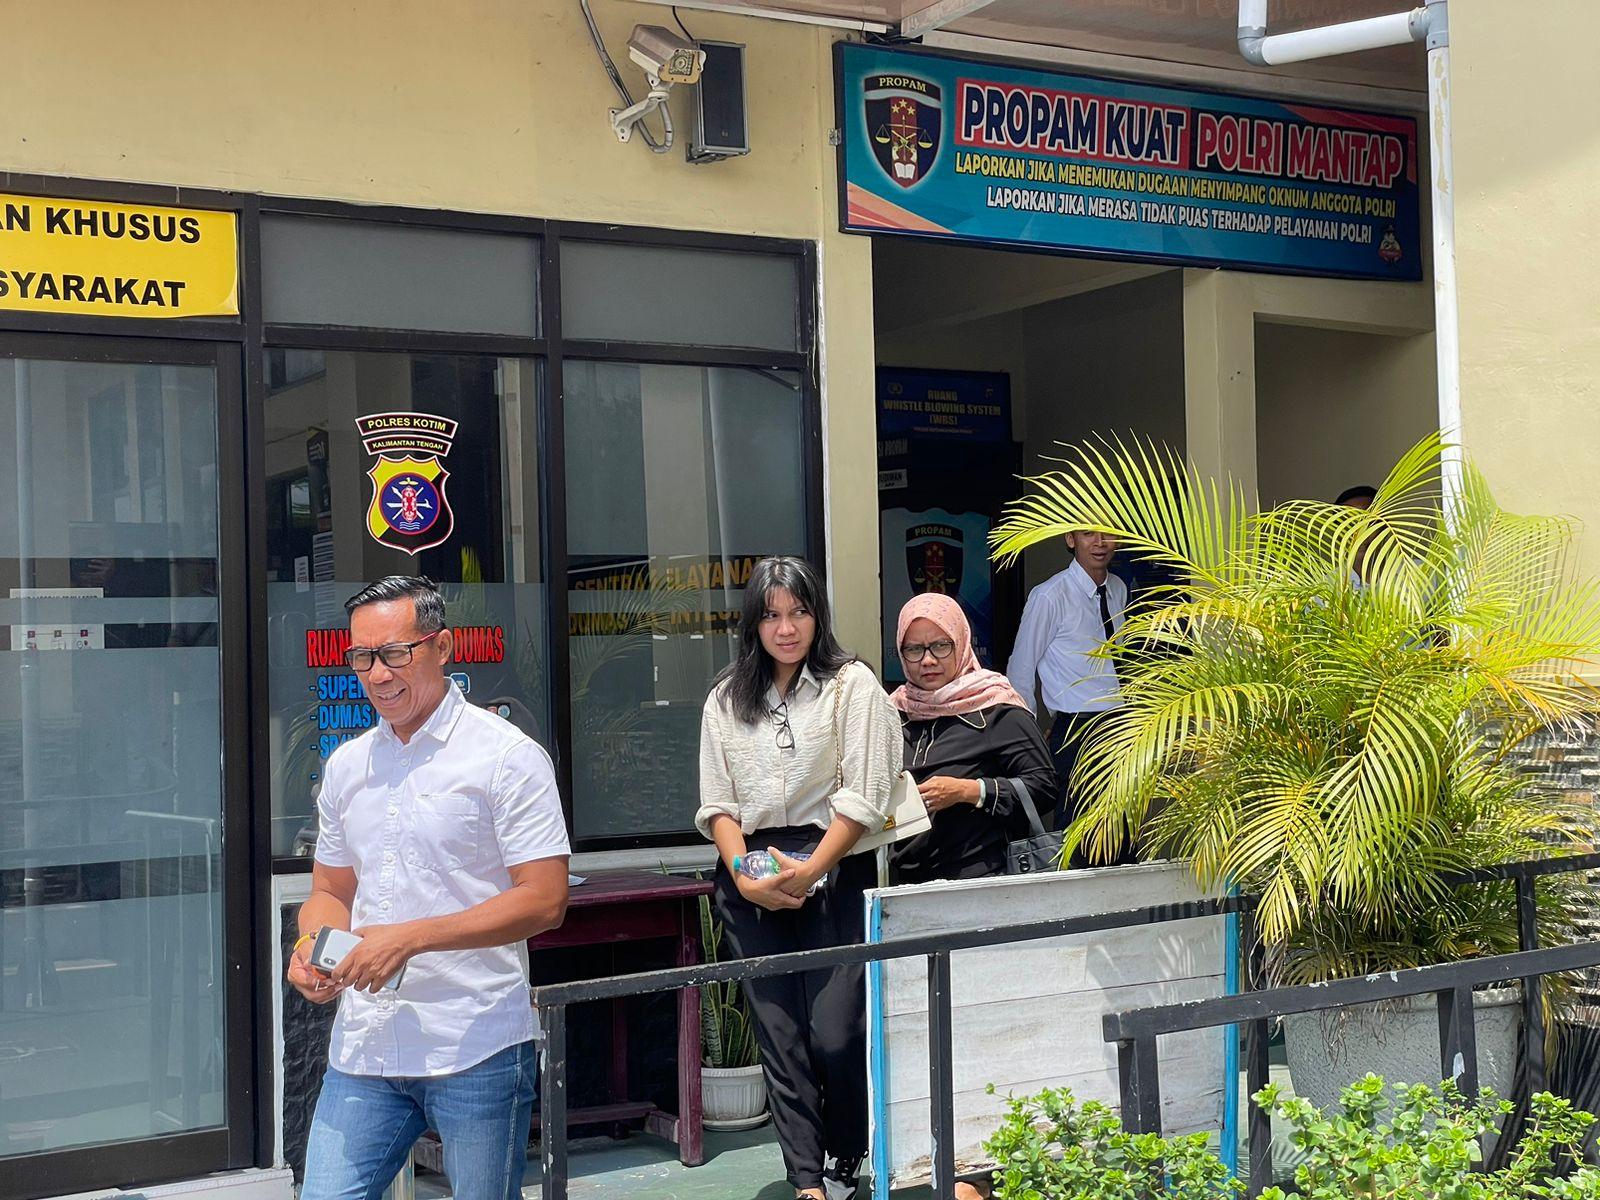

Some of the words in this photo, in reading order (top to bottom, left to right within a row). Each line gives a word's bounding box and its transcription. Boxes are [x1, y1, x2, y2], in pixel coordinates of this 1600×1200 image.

[879, 77, 927, 94] PROPAM
[963, 84, 1100, 154] PROPAM
[1104, 102, 1187, 165] KUAT
[1196, 113, 1283, 177] POLRI
[1287, 125, 1403, 189] MANTAP
[956, 151, 1024, 179] LAPORKAN
[1027, 161, 1055, 183] JIKA
[1058, 163, 1135, 192] MENEMUKAN
[1138, 172, 1188, 197] DUGAAN
[1190, 178, 1266, 206] MENYIMPANG
[1270, 187, 1308, 208] OKNUM
[1311, 191, 1362, 215] ANGGOTA
[1365, 197, 1396, 219] POLRI
[46, 206, 201, 244] KHUSUS
[987, 186, 1056, 213] LAPORKAN
[1058, 192, 1085, 216] JIKA
[1088, 197, 1138, 221] MERASA
[1141, 203, 1176, 225] TIDAK
[1178, 207, 1209, 228] PUAS
[1211, 210, 1271, 234] TERHADAP
[1274, 216, 1338, 241] PELAYANAN
[1340, 222, 1372, 244] POLRI
[367, 417, 411, 430] POLRES
[414, 417, 446, 431] KOTIM
[372, 439, 415, 449] KALIMANTAN
[416, 440, 443, 450] TENGAH
[914, 525, 952, 537] PROPAM
[453, 626, 504, 664] DUMAS
